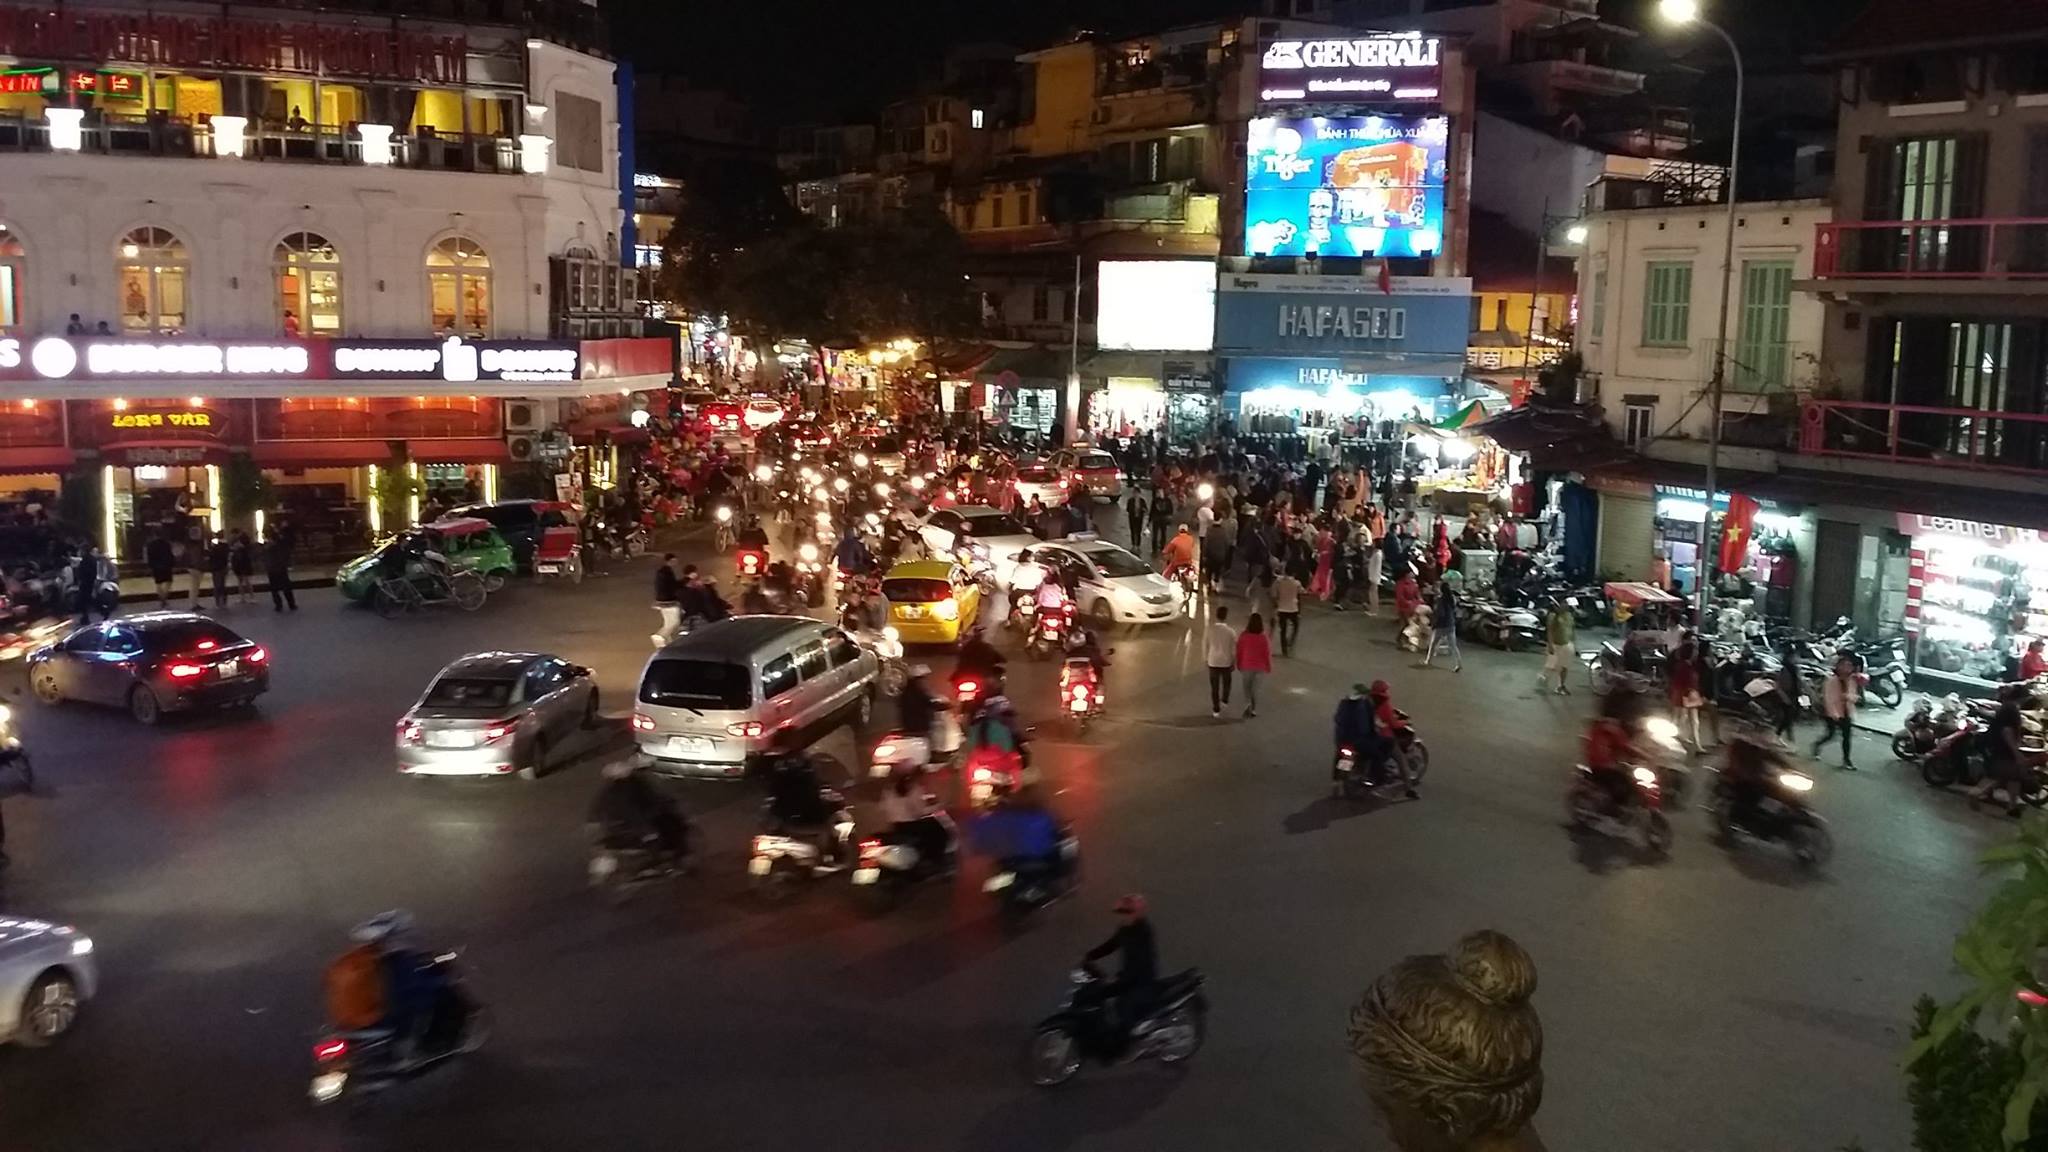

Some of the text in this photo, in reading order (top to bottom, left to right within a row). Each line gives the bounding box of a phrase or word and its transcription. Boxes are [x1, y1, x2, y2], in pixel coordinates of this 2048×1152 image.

[1303, 39, 1439, 67] GENERALI
[1263, 154, 1314, 181] Tiger
[1279, 305, 1406, 340] HAFASCO
